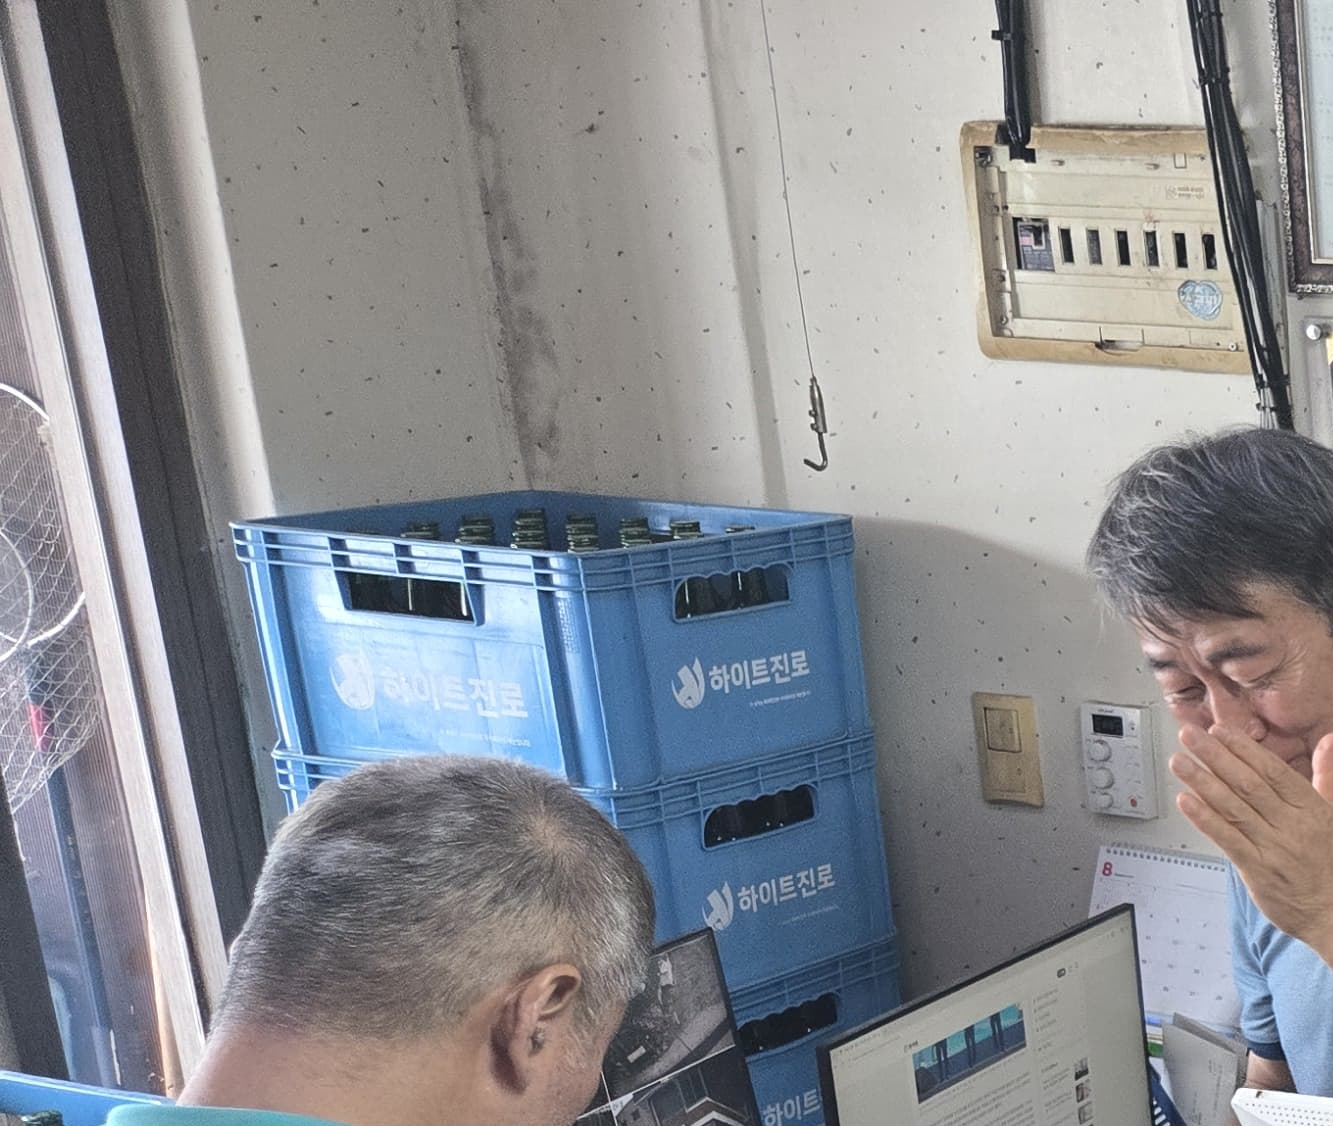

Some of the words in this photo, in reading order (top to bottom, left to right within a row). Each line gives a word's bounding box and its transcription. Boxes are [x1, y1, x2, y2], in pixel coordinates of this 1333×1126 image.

[383, 668, 529, 718] 하이트진로
[708, 649, 811, 694] 하이트진로
[737, 863, 836, 913] 하이트진로
